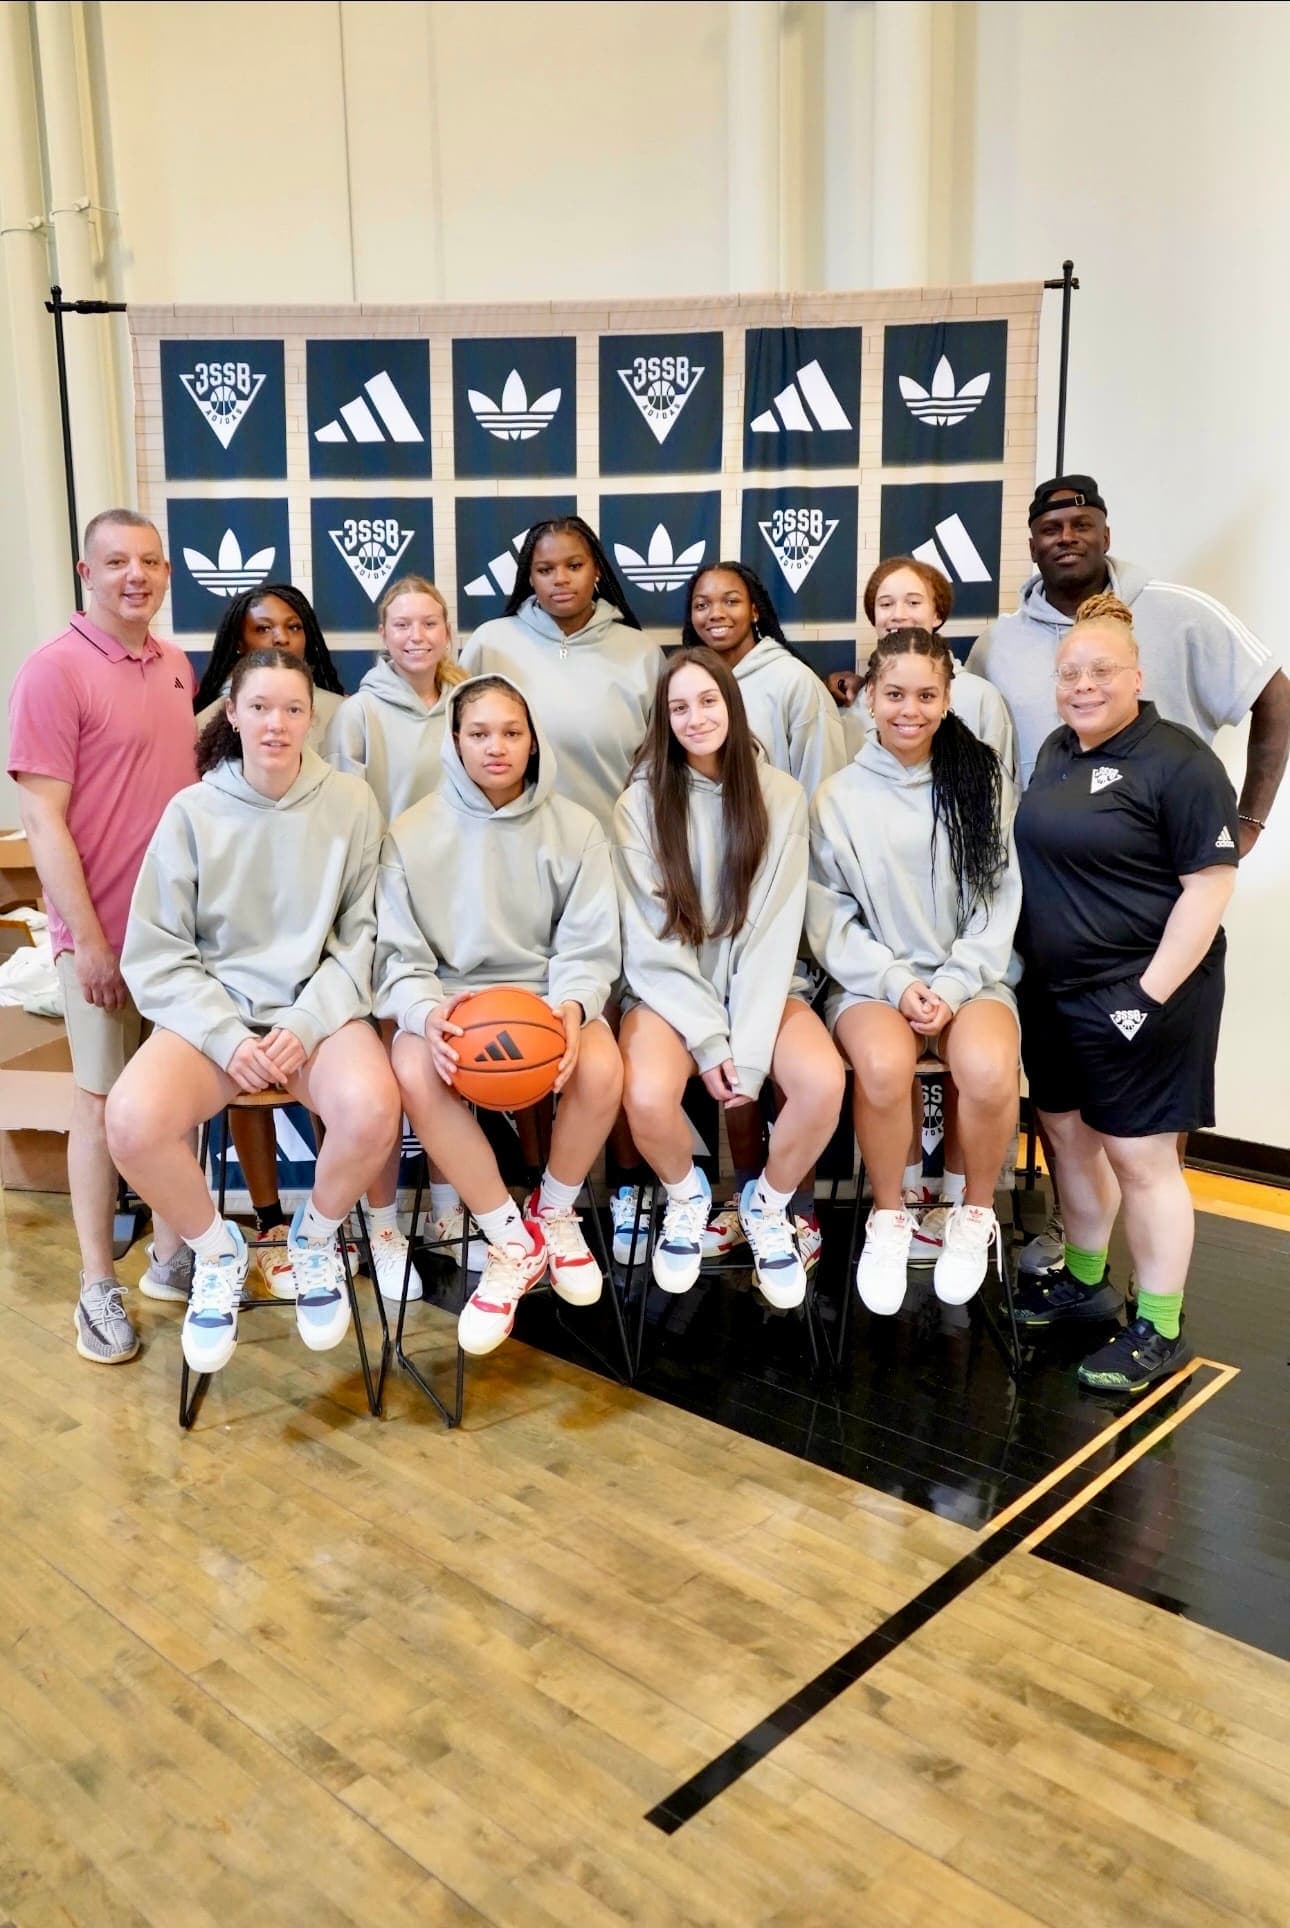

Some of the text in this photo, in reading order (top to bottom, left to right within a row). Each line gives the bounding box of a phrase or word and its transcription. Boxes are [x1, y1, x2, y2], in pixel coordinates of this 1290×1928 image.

[194, 362, 251, 396] 3SSB
[633, 356, 690, 391] 3SSB
[343, 519, 400, 551] 3SSB
[772, 508, 823, 542] 3SSB
[921, 1084, 943, 1105] SS
